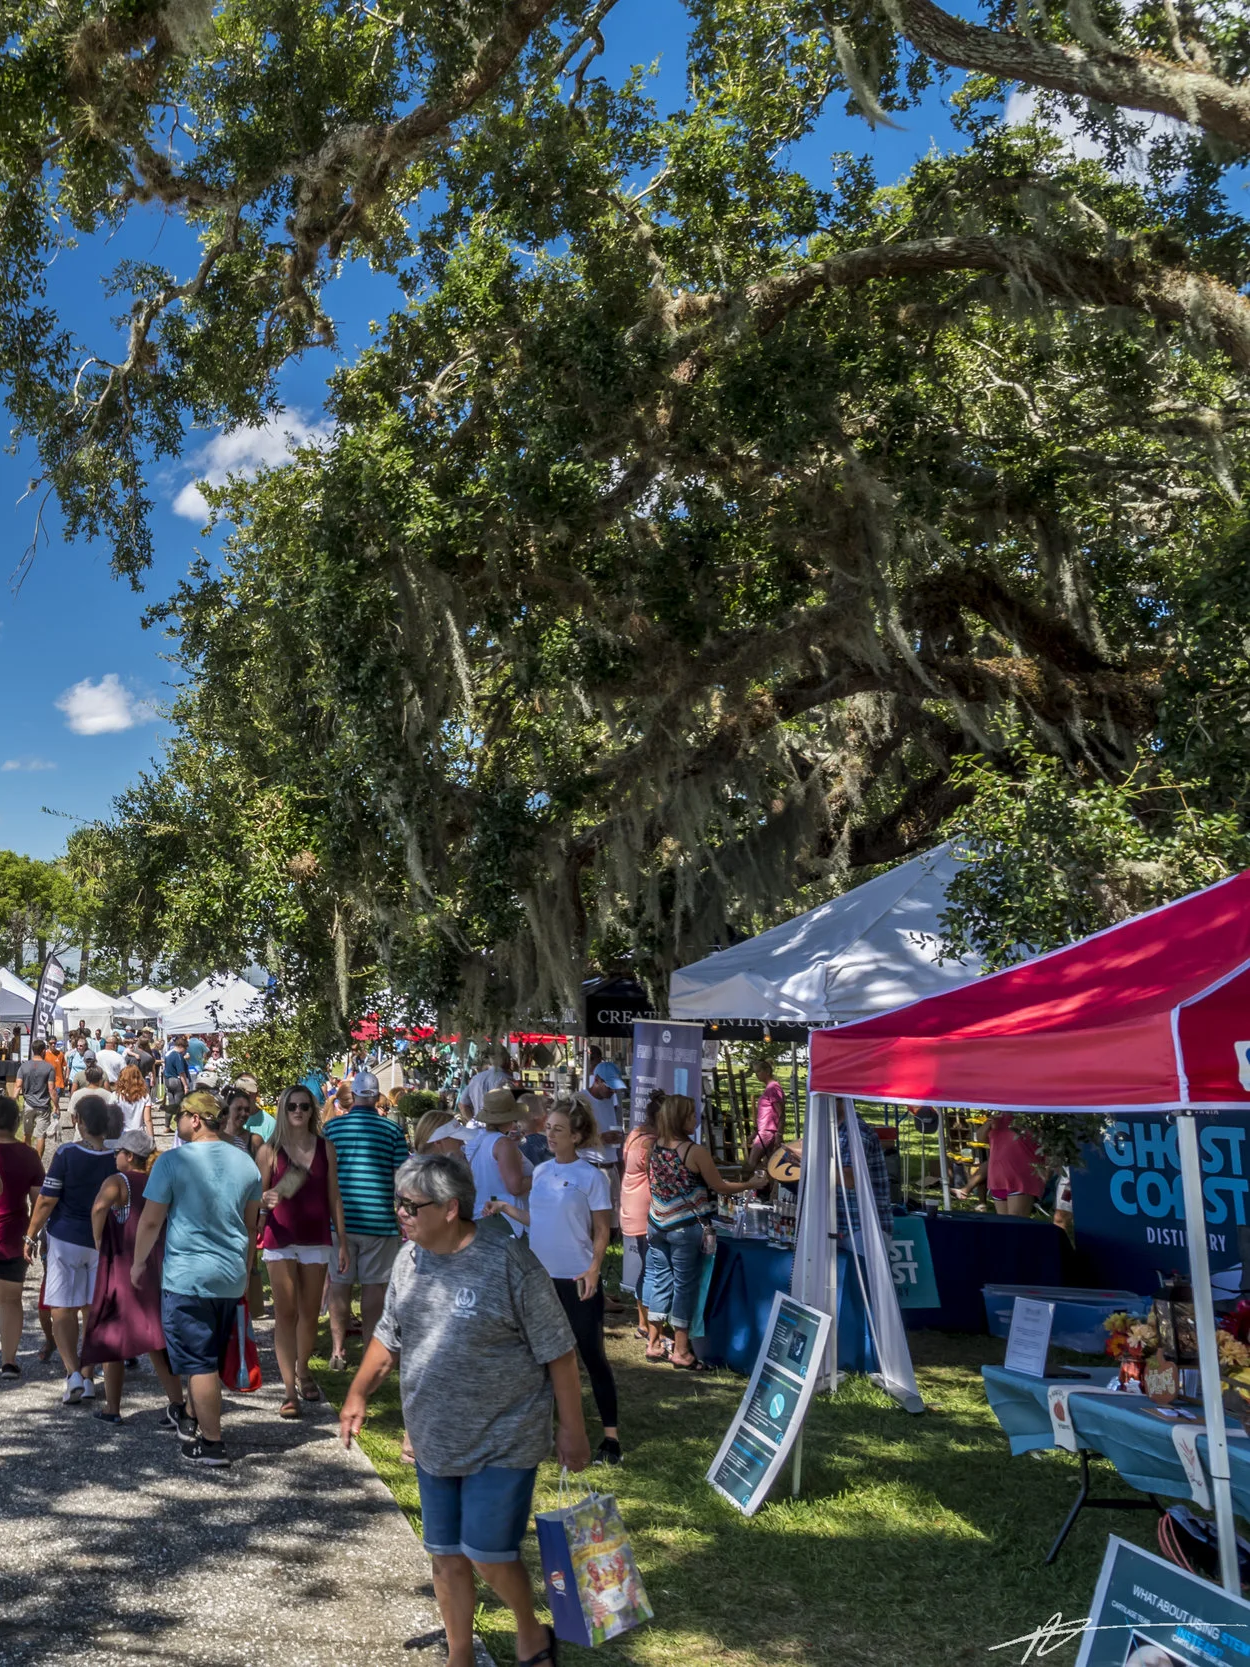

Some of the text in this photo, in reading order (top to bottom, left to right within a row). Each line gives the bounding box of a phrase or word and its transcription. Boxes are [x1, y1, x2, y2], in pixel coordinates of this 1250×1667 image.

[1111, 1600, 1139, 1620] CARTILAGE
[1133, 1584, 1157, 1607] WHAT
[1156, 1598, 1190, 1624] ABOUT
[1189, 1615, 1220, 1640] USING
